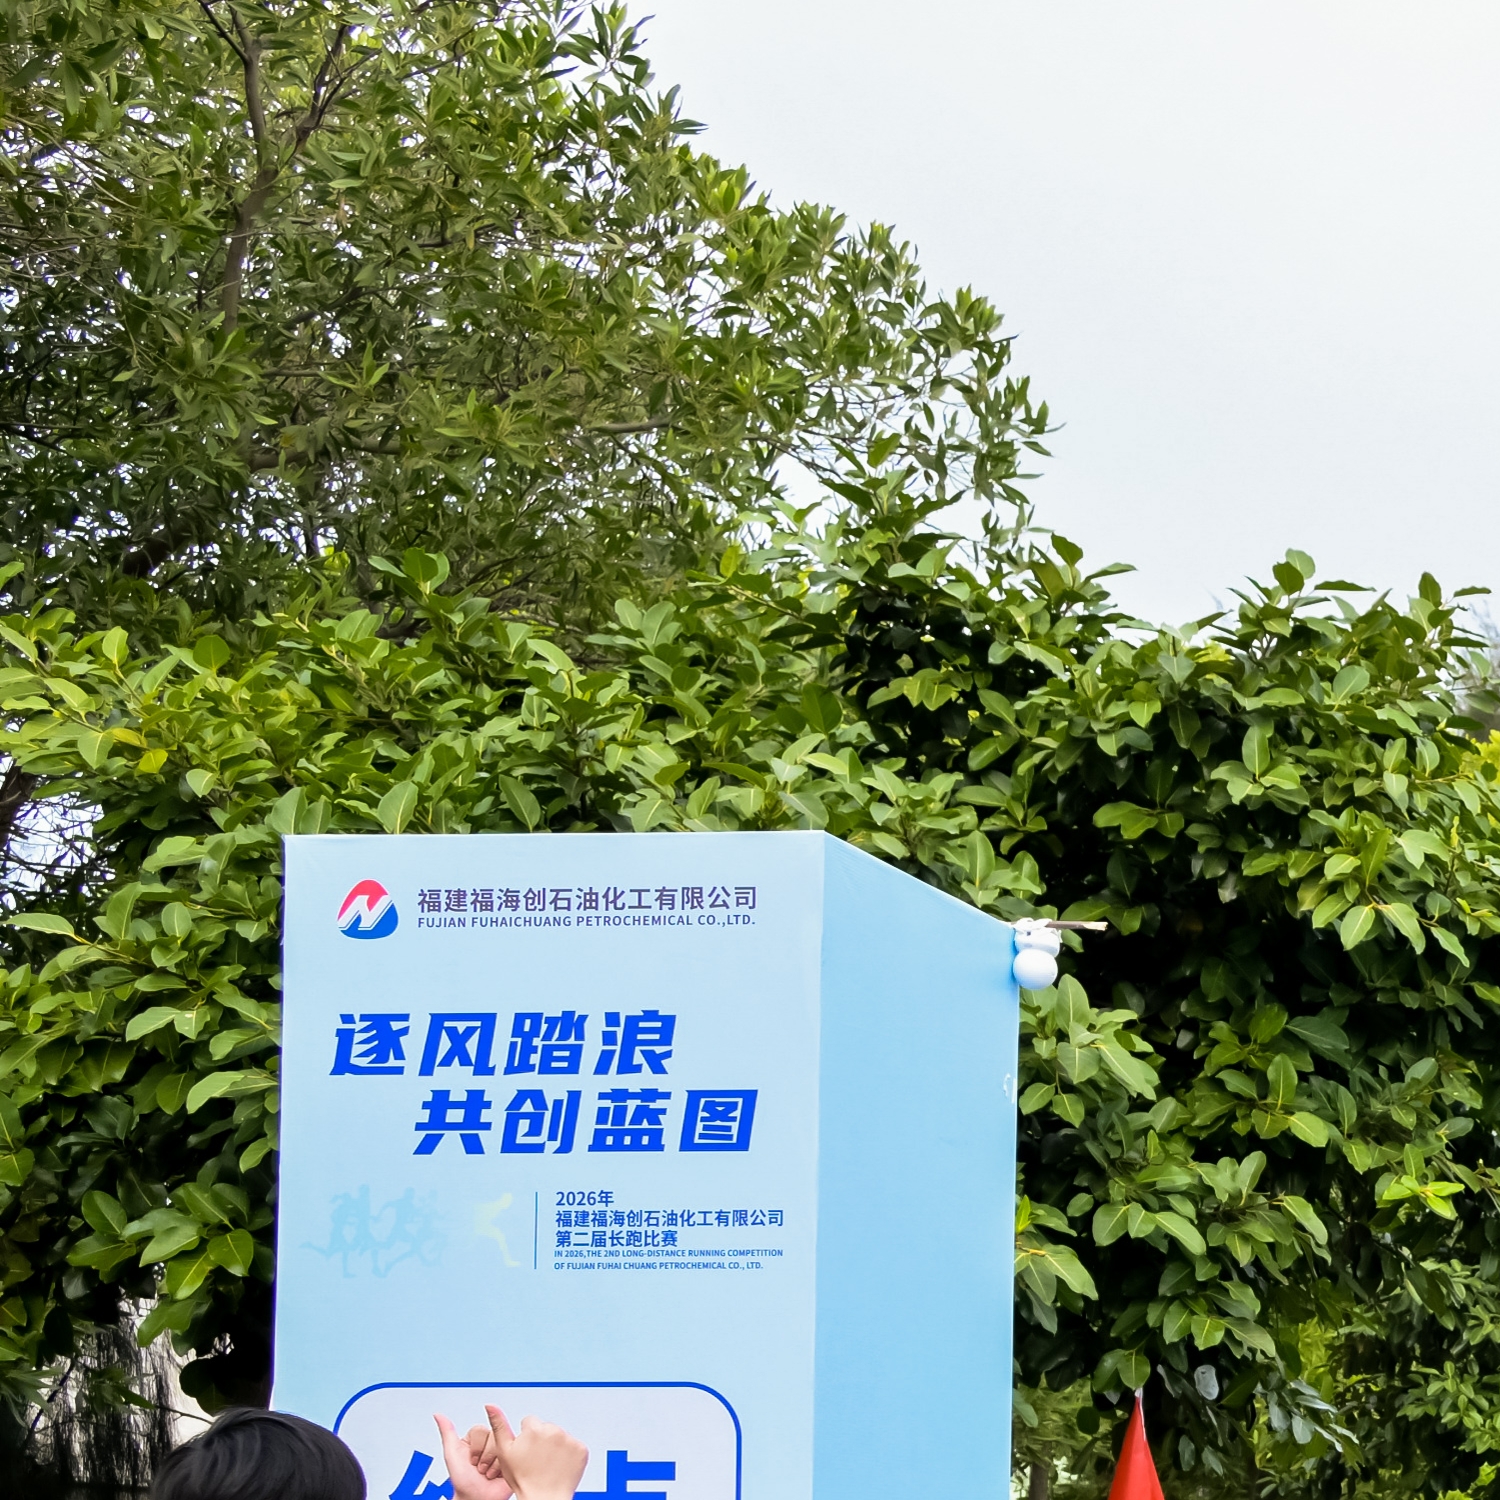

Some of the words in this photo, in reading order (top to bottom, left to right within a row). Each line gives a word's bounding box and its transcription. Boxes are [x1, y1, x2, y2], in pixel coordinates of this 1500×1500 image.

[417, 886, 756, 913] 福建福海创石油化工有限公司
[418, 917, 466, 928] FUJIAN
[472, 916, 571, 927] FUHAICHUANG
[577, 915, 693, 927] PETROCHEMICAL
[698, 914, 755, 927] CO.,LTD.
[329, 1010, 676, 1076] 逐风踏浪
[413, 1088, 758, 1155] 共创蓝图
[556, 1190, 614, 1207] 2026年
[555, 1209, 783, 1228] 福建福海创石油化工有限公司
[556, 1230, 677, 1248] 第二届长跑比赛
[554, 1250, 563, 1258] IN
[604, 1250, 620, 1258] 2ND
[622, 1249, 686, 1258] LONG-DISTANCE
[688, 1249, 726, 1257] RUNNING
[727, 1249, 784, 1257] COMPETITION
[554, 1262, 565, 1270] OF
[567, 1262, 595, 1270] FUJIAN
[597, 1262, 622, 1270] FUHAI
[623, 1262, 657, 1270] CHUANG
[659, 1262, 726, 1270] PETROCHEMICAL
[746, 1261, 763, 1270] LTD.
